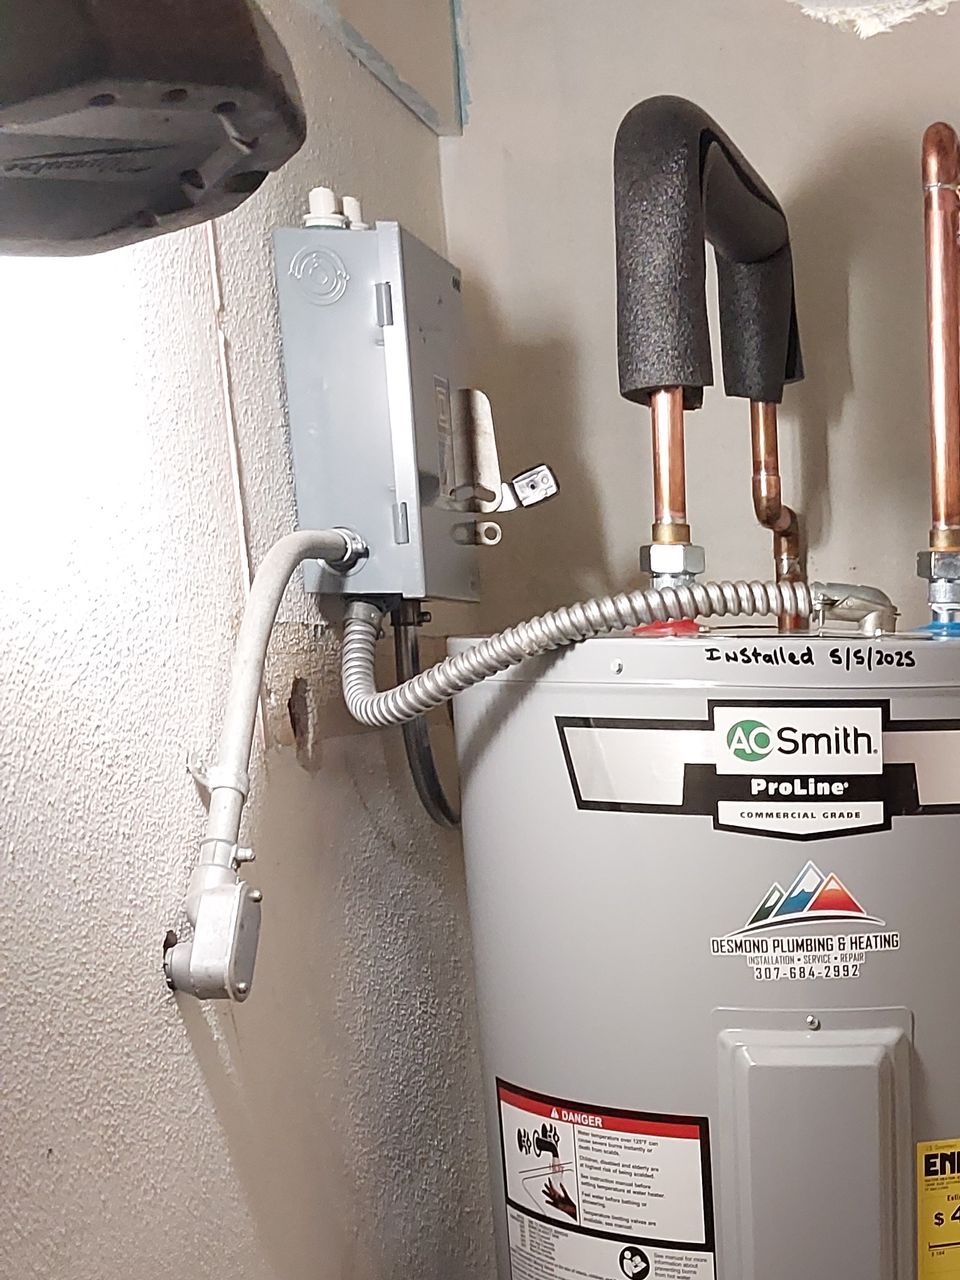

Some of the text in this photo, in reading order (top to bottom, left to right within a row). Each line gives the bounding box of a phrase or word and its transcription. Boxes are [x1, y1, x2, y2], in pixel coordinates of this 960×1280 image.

[830, 647, 915, 671] 5/5/2025
[777, 725, 872, 754] Smith
[751, 778, 843, 795] ProLine
[712, 934, 899, 953] DESMOND PLUMBING & HEATING
[750, 953, 864, 965] INSTALLATION SERVICE REPAIR
[756, 965, 858, 979] 307-684-2992
[562, 1111, 602, 1127] DANGER
[934, 1212, 944, 1227] $
